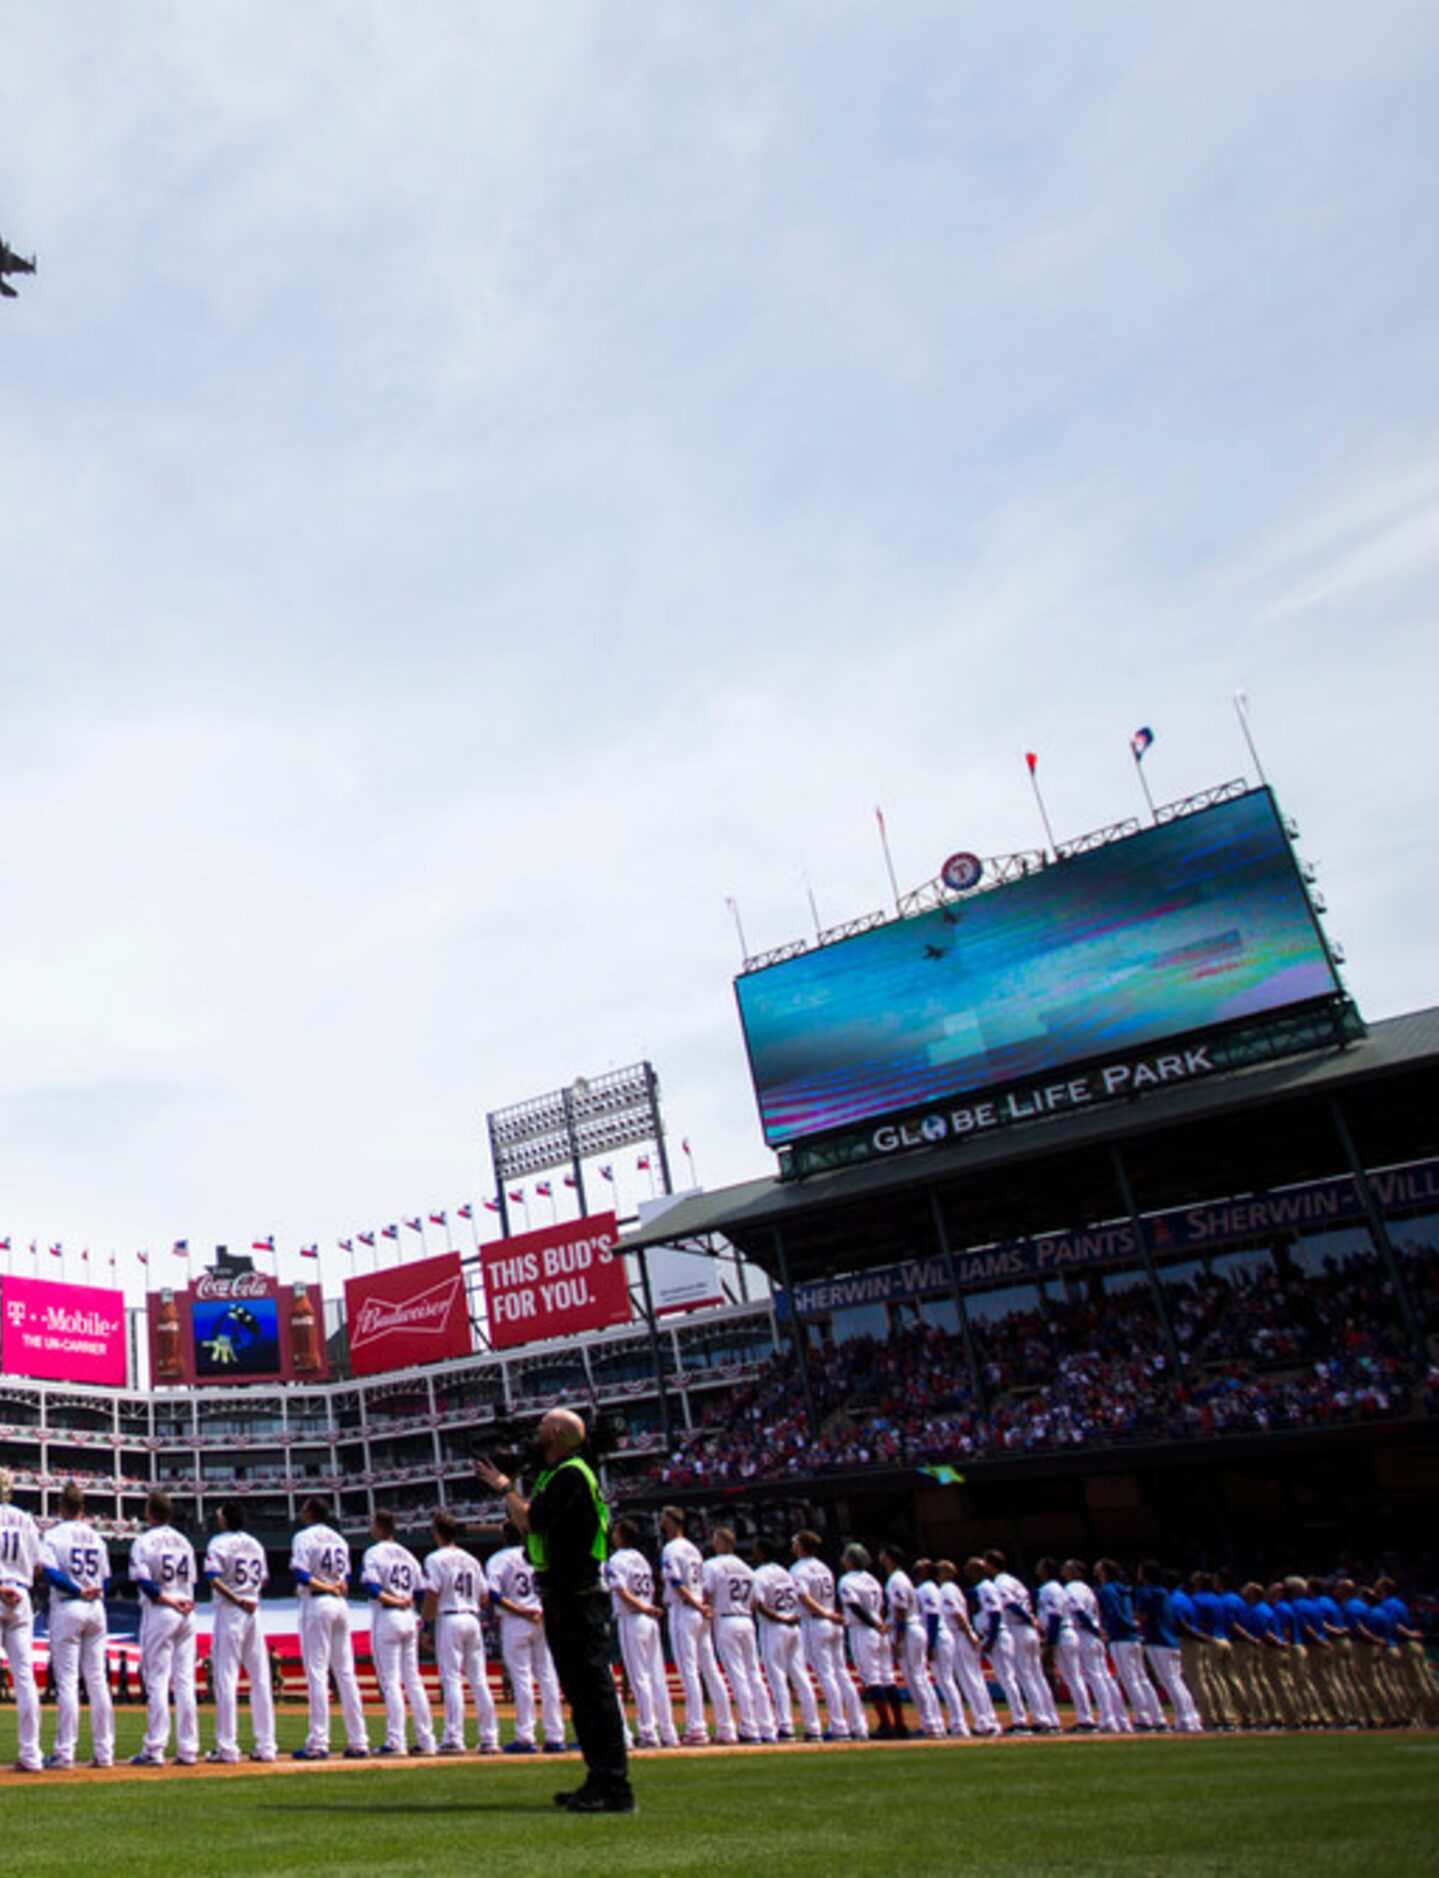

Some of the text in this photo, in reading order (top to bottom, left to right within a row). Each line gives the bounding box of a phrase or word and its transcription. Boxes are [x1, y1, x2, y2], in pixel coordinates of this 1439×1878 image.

[873, 1046, 1214, 1151] GLOBE LIFE PARK
[488, 1234, 614, 1290] THIS BUD'S
[1035, 1227, 1137, 1268] PAINTS
[492, 1276, 596, 1324] FOR YOU.
[357, 1299, 450, 1334] Budweiser
[22, 1334, 107, 1355] THE UN-CARRIER
[2, 1531, 20, 1561] 11
[71, 1547, 99, 1577] 55
[161, 1553, 189, 1582] 54
[390, 1564, 411, 1591] 43
[454, 1571, 473, 1598] 41
[728, 1576, 752, 1602] 27
